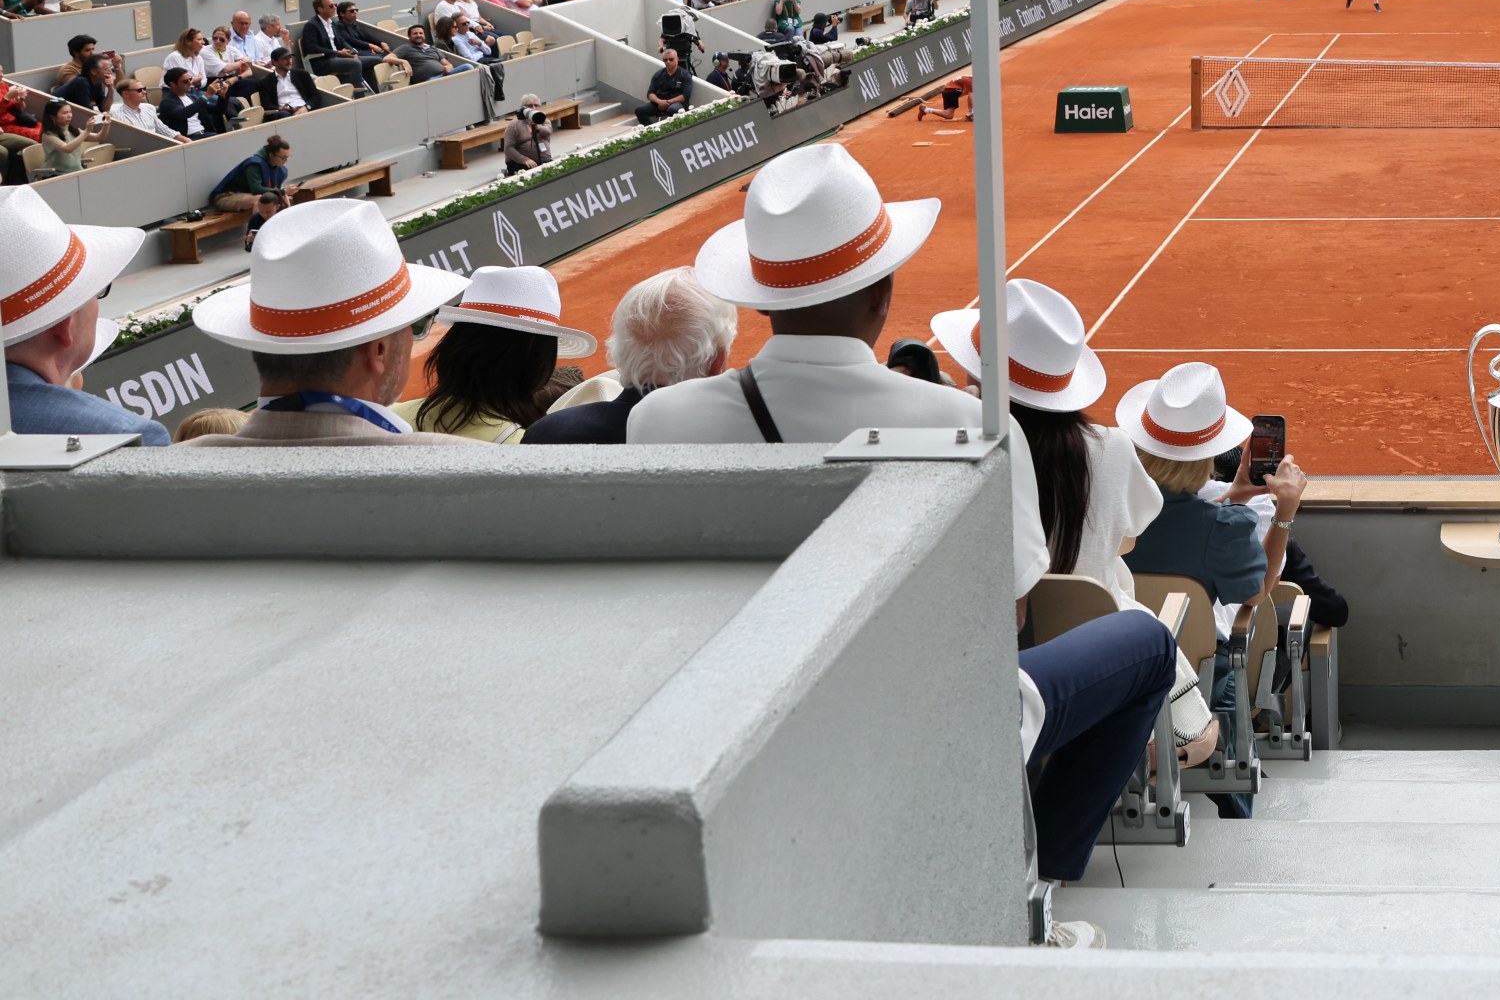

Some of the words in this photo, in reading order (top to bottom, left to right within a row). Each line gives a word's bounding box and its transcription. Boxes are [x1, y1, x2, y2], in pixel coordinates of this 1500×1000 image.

[1016, 4, 1046, 28] Emirates
[1064, 103, 1115, 120] Haier
[533, 171, 639, 237] RENAULT
[680, 121, 759, 174] RENAULT
[24, 283, 54, 304] TRIBUNE
[350, 298, 380, 316] TRIBUNE
